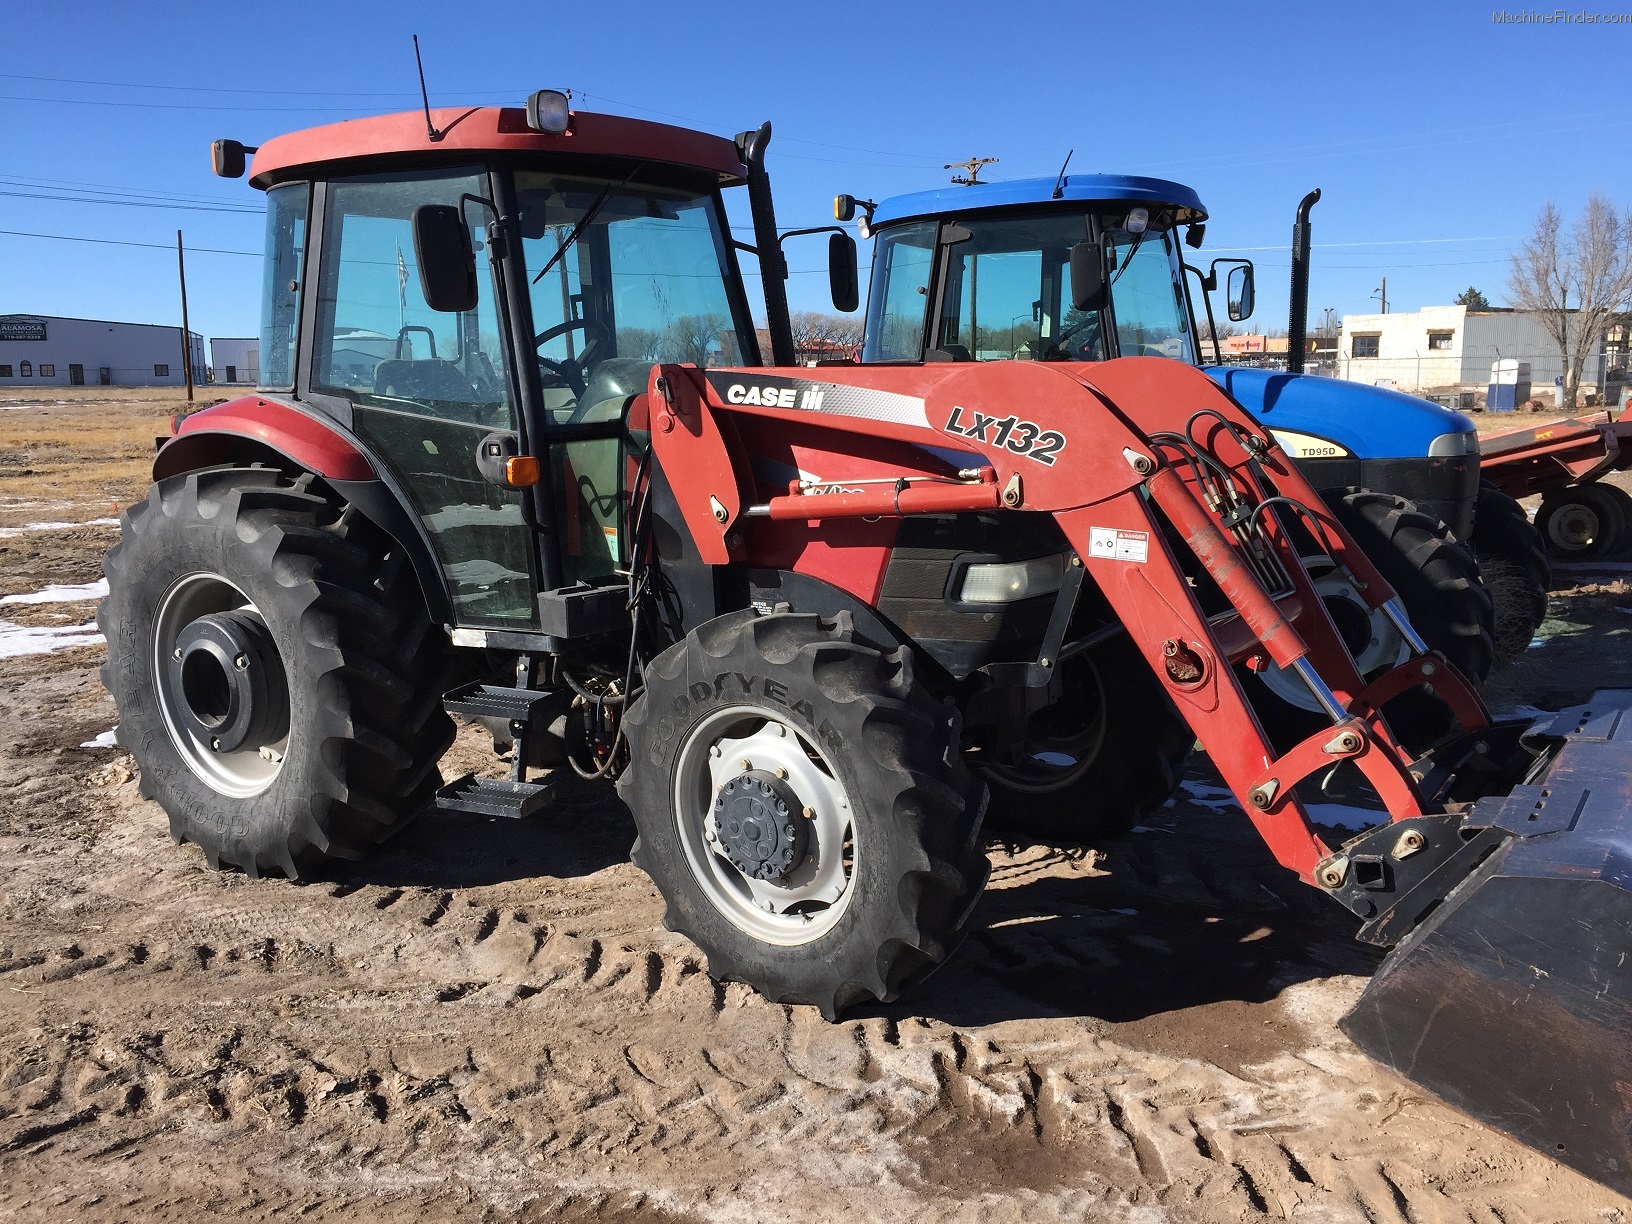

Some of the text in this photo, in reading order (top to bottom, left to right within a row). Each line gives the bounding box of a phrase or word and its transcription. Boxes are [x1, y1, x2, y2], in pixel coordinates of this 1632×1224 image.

[727, 384, 797, 408] CASE
[944, 405, 1067, 467] LX132
[1301, 447, 1336, 456] TD95D
[1124, 532, 1146, 540] DANGER
